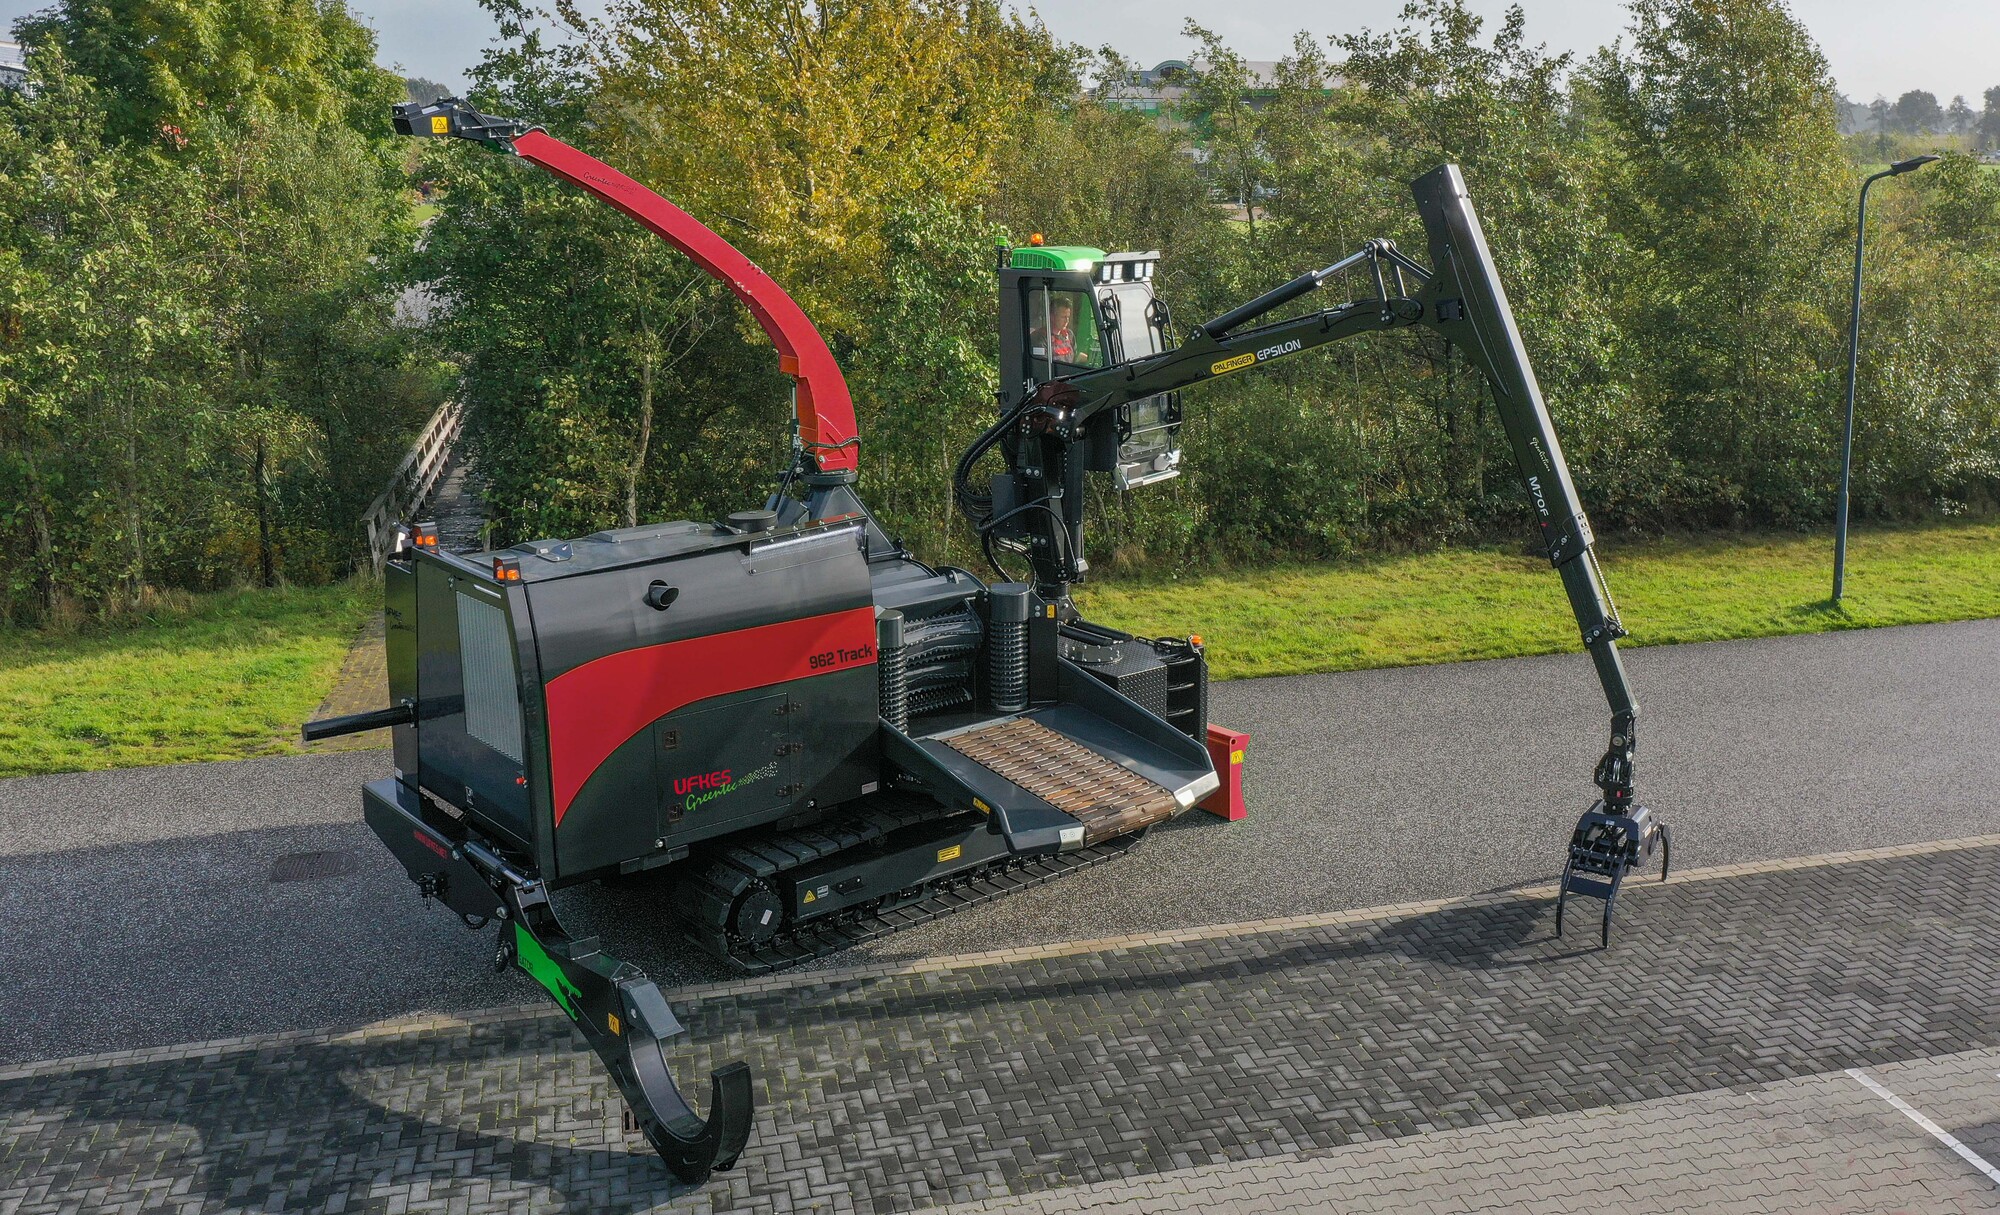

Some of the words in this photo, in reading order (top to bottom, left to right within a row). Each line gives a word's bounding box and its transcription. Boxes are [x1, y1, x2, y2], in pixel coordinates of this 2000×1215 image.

[1213, 354, 1253, 373] PALFINGER
[1256, 339, 1302, 361] EPSILON
[809, 651, 835, 669] 962
[837, 644, 873, 664] Track
[673, 769, 732, 796] UFKES
[686, 781, 738, 811] Greentec
